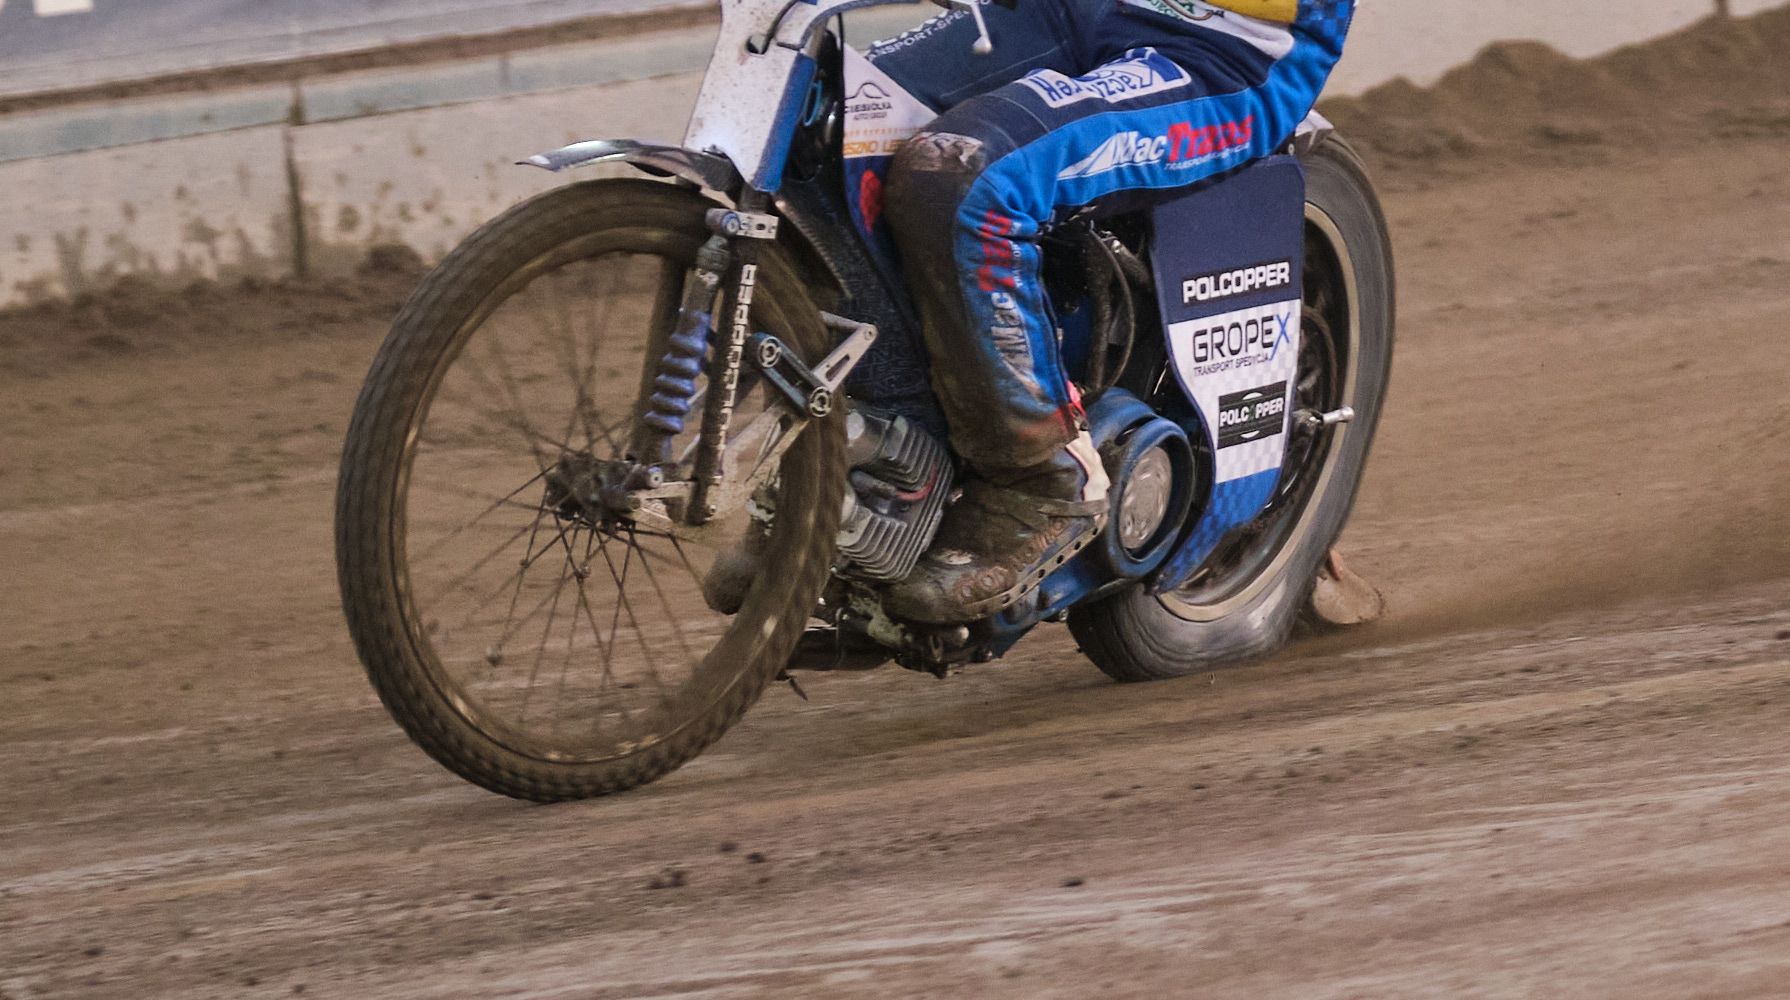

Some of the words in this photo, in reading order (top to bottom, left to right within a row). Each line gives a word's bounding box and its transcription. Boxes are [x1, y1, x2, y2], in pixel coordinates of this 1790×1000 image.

[1110, 114, 1256, 168] MacTrans
[1182, 261, 1291, 304] POLCOPPER
[1192, 311, 1291, 364] GROPEX
[1193, 358, 1234, 377] TRANSPORT
